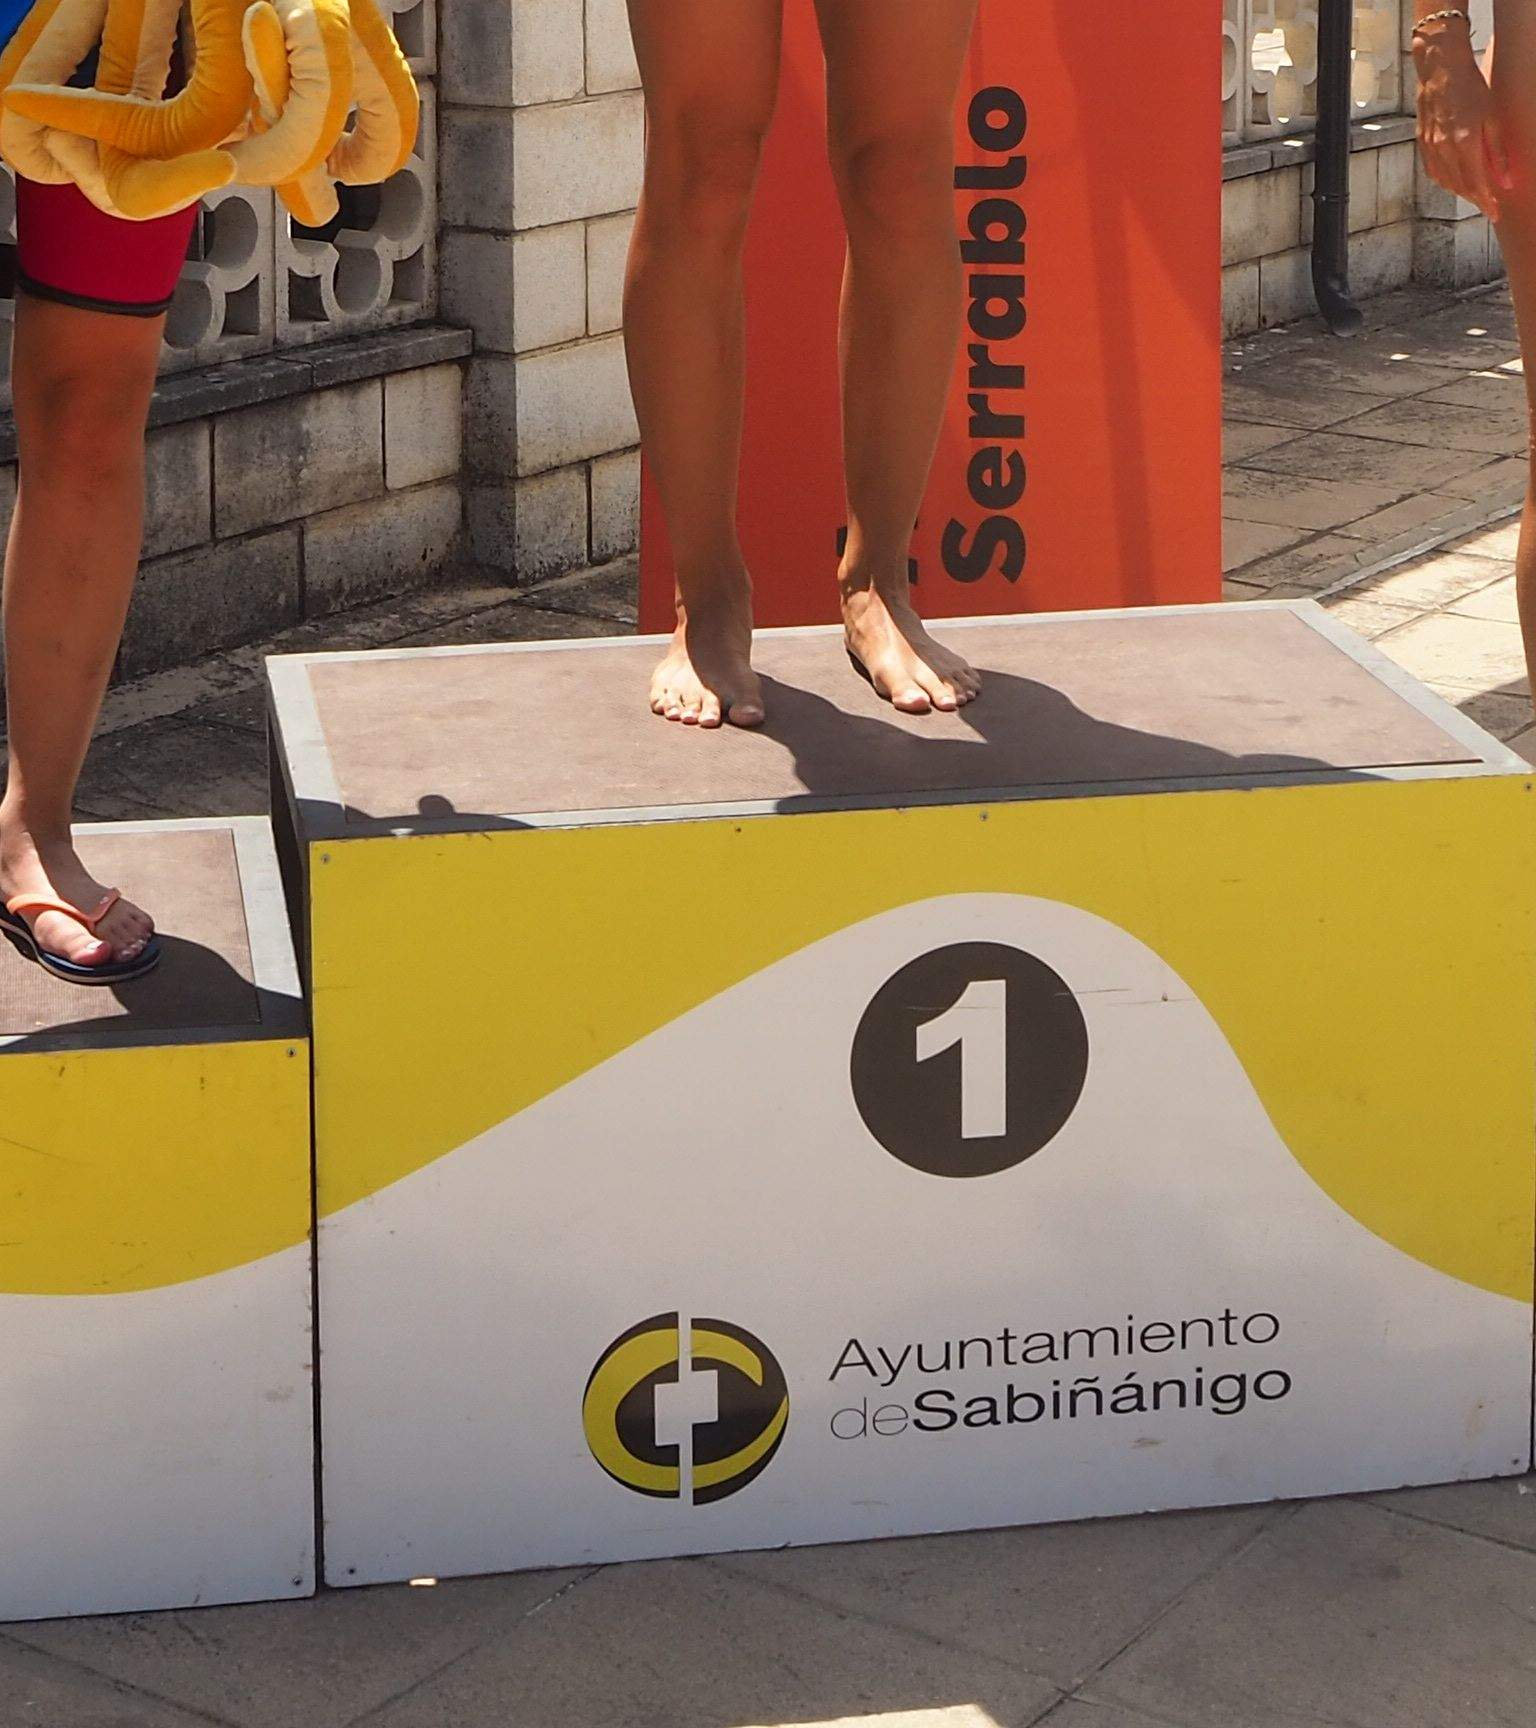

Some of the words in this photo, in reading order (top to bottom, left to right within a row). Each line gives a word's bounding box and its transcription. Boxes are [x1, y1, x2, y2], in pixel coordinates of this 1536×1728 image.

[940, 85, 1028, 584] Serrablo
[916, 979, 1007, 1140] 1
[828, 1308, 1281, 1387] Ayuntamiento
